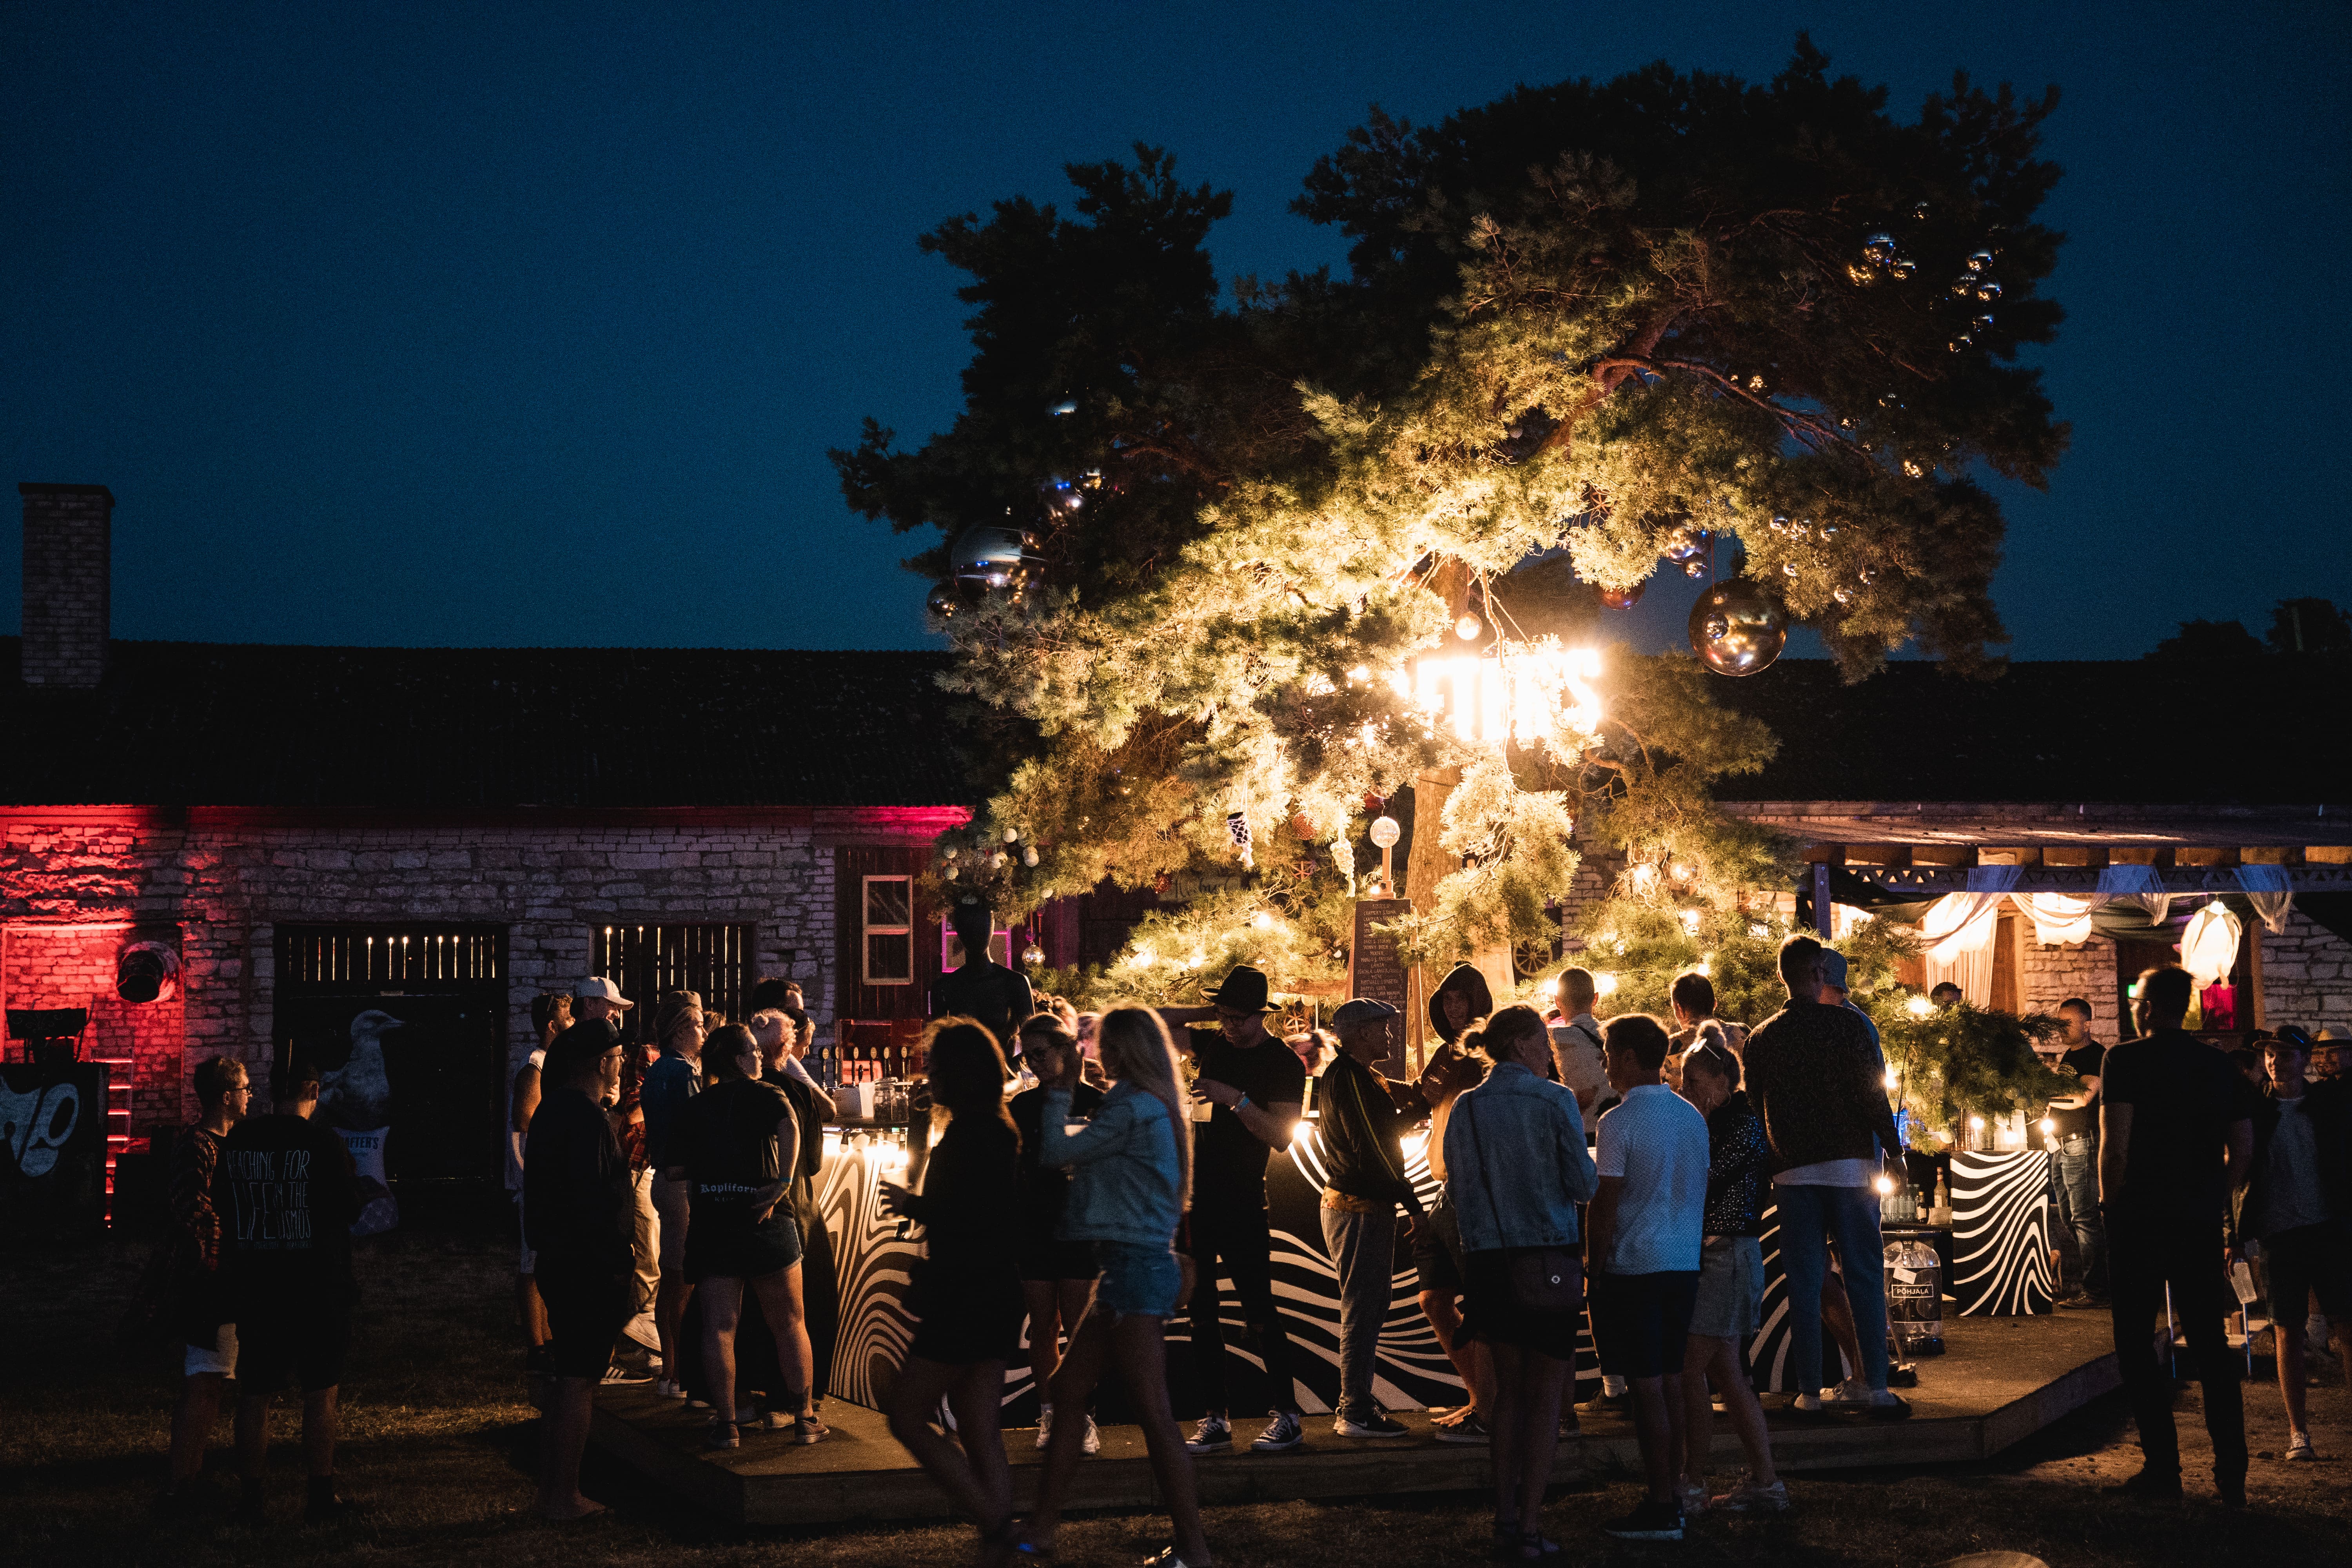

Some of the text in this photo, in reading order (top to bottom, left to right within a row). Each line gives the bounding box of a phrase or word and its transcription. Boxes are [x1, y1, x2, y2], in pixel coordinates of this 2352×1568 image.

[226, 1149, 310, 1180] REACHING FOR
[288, 1181, 309, 1208] THE
[232, 1181, 276, 1241] LIFE
